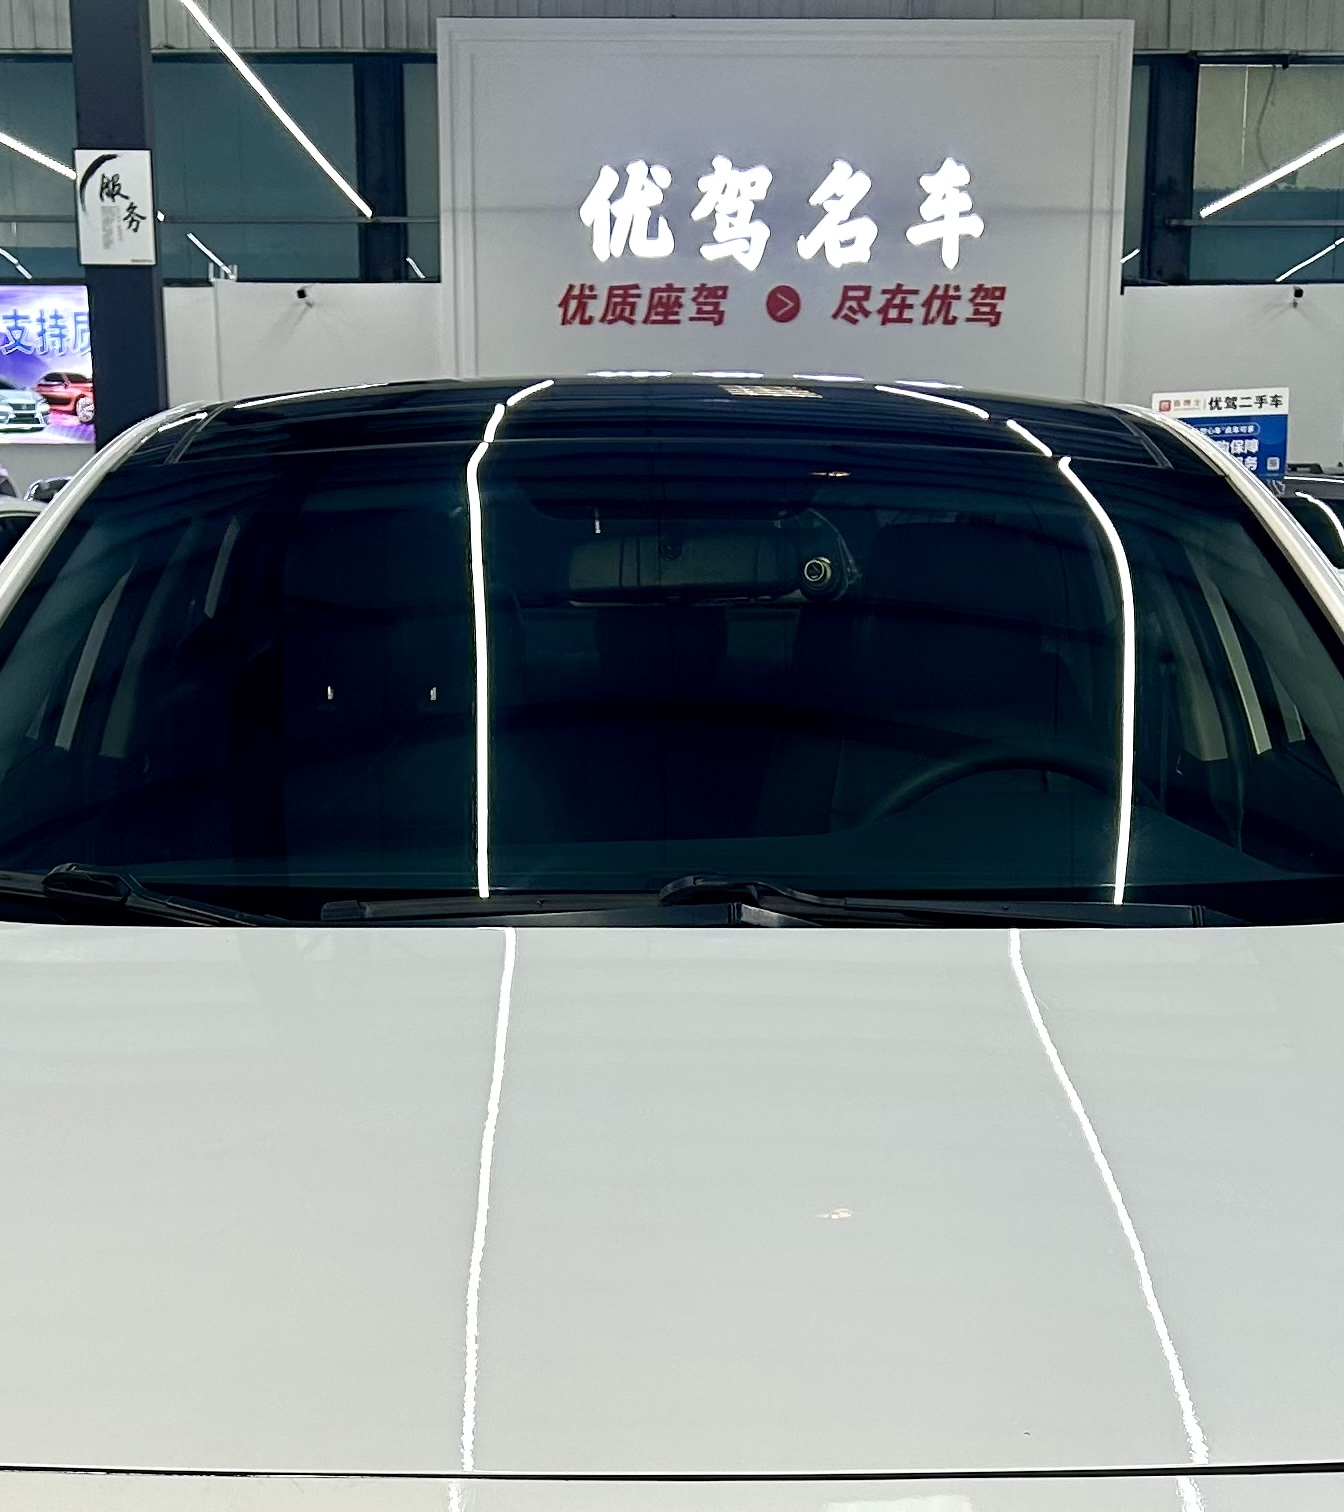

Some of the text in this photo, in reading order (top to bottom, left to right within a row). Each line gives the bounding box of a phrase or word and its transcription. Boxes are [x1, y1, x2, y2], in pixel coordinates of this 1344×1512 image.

[99, 173, 147, 233] 服务
[579, 155, 985, 271] 优驾名车
[558, 282, 1007, 327] 优质座驾 尽在优驾
[1208, 394, 1283, 411] 优驾二手车
